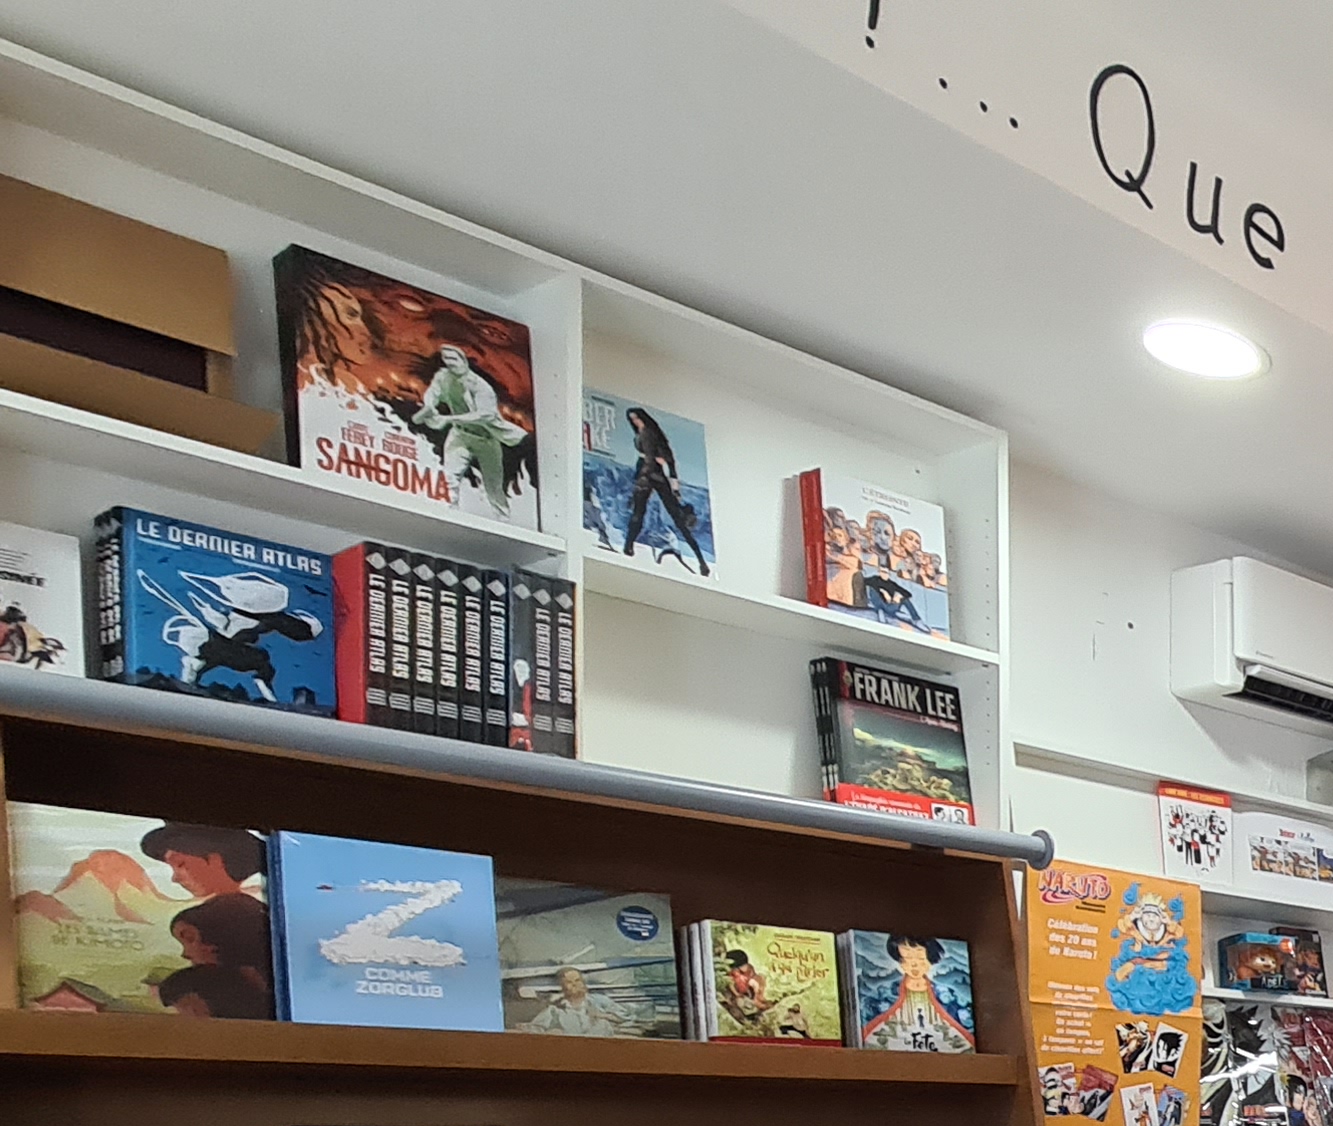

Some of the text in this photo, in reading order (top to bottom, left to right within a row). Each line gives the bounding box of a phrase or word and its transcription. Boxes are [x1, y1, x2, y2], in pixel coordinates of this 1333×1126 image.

[1089, 64, 1285, 270] Que
[316, 436, 452, 504] SANGOMA
[137, 518, 323, 577] LE DERNIER ATLAS
[853, 672, 958, 720] FRANK LEE
[1039, 870, 1112, 901] NARUTO
[355, 979, 445, 999] ZORGLUB
[363, 966, 433, 982] COMME
